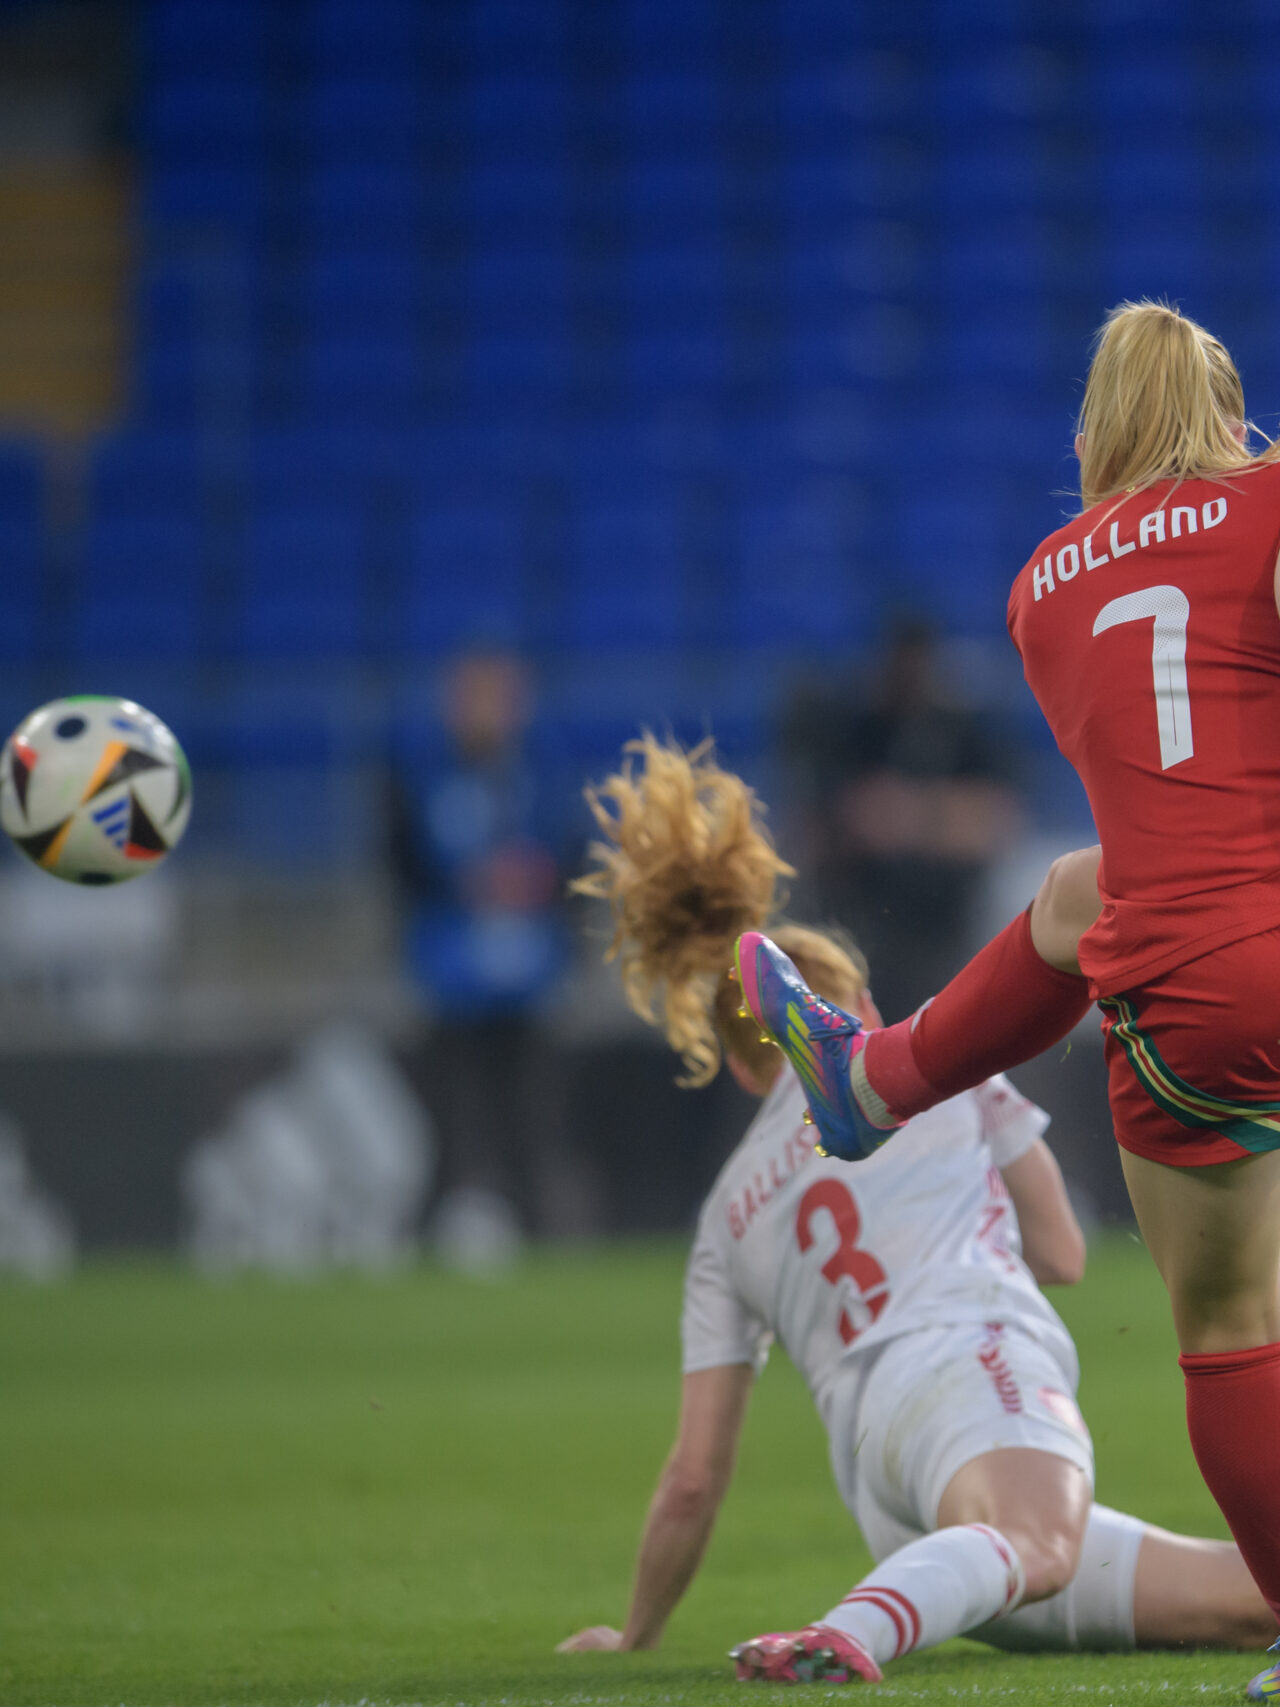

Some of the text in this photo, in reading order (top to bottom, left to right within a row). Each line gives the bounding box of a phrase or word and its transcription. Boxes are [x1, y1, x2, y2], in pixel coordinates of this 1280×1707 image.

[1033, 497, 1228, 602] HOLLAND
[1092, 585, 1194, 770] 7
[726, 1123, 820, 1240] BALLIS
[795, 1177, 892, 1347] 3
